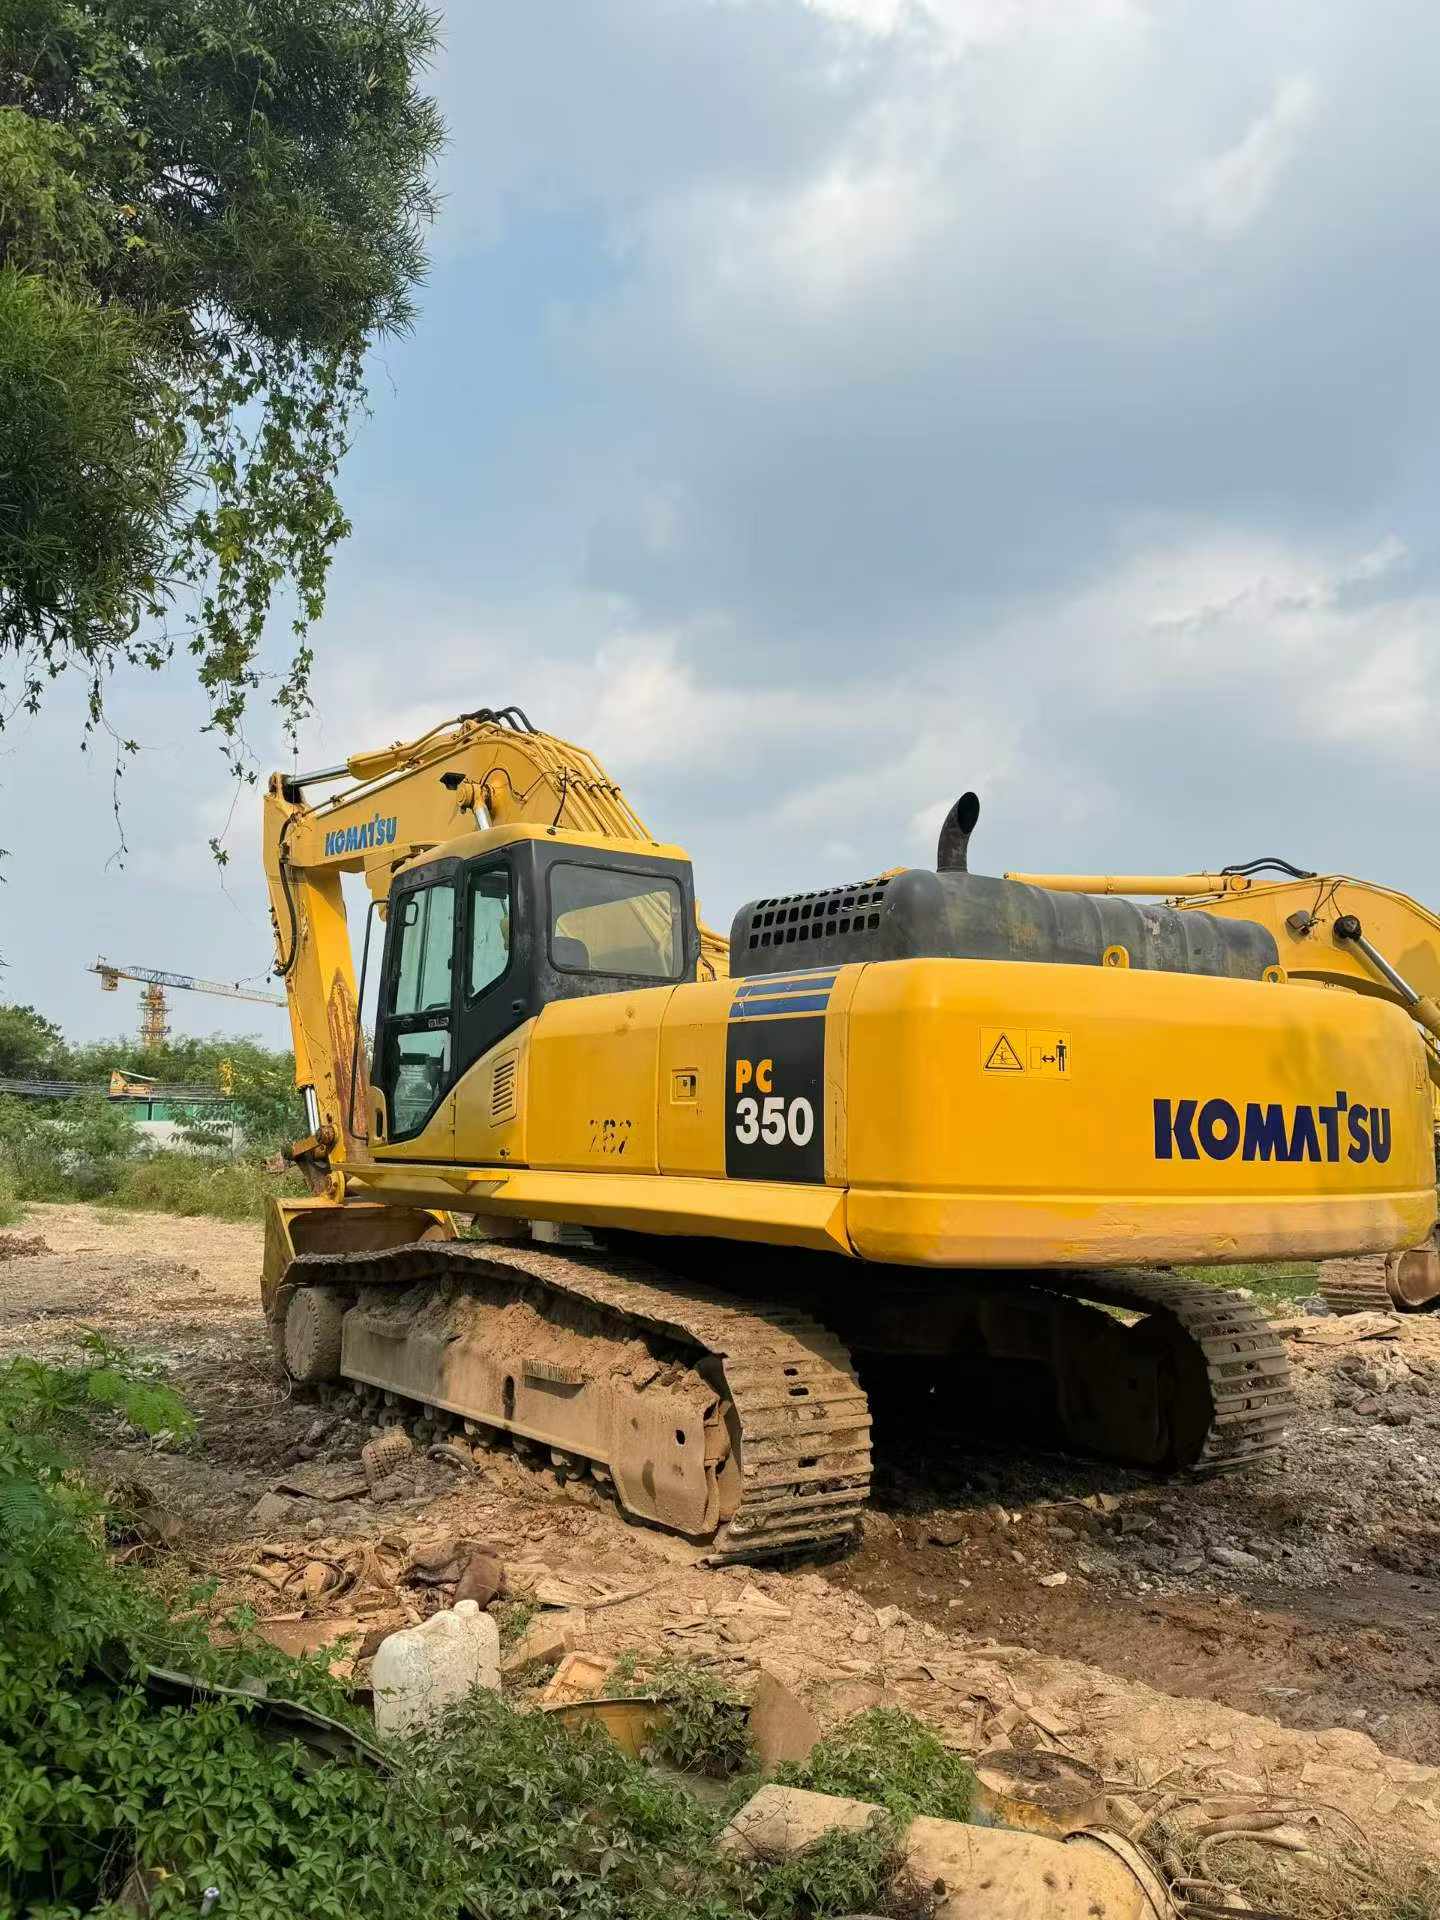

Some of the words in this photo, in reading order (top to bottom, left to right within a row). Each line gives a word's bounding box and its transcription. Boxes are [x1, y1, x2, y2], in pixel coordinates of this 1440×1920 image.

[325, 813, 397, 856] KOMATSU
[735, 1059, 773, 1094] PC
[735, 1096, 814, 1147] 350
[1153, 1090, 1392, 1164] KOMATSU
